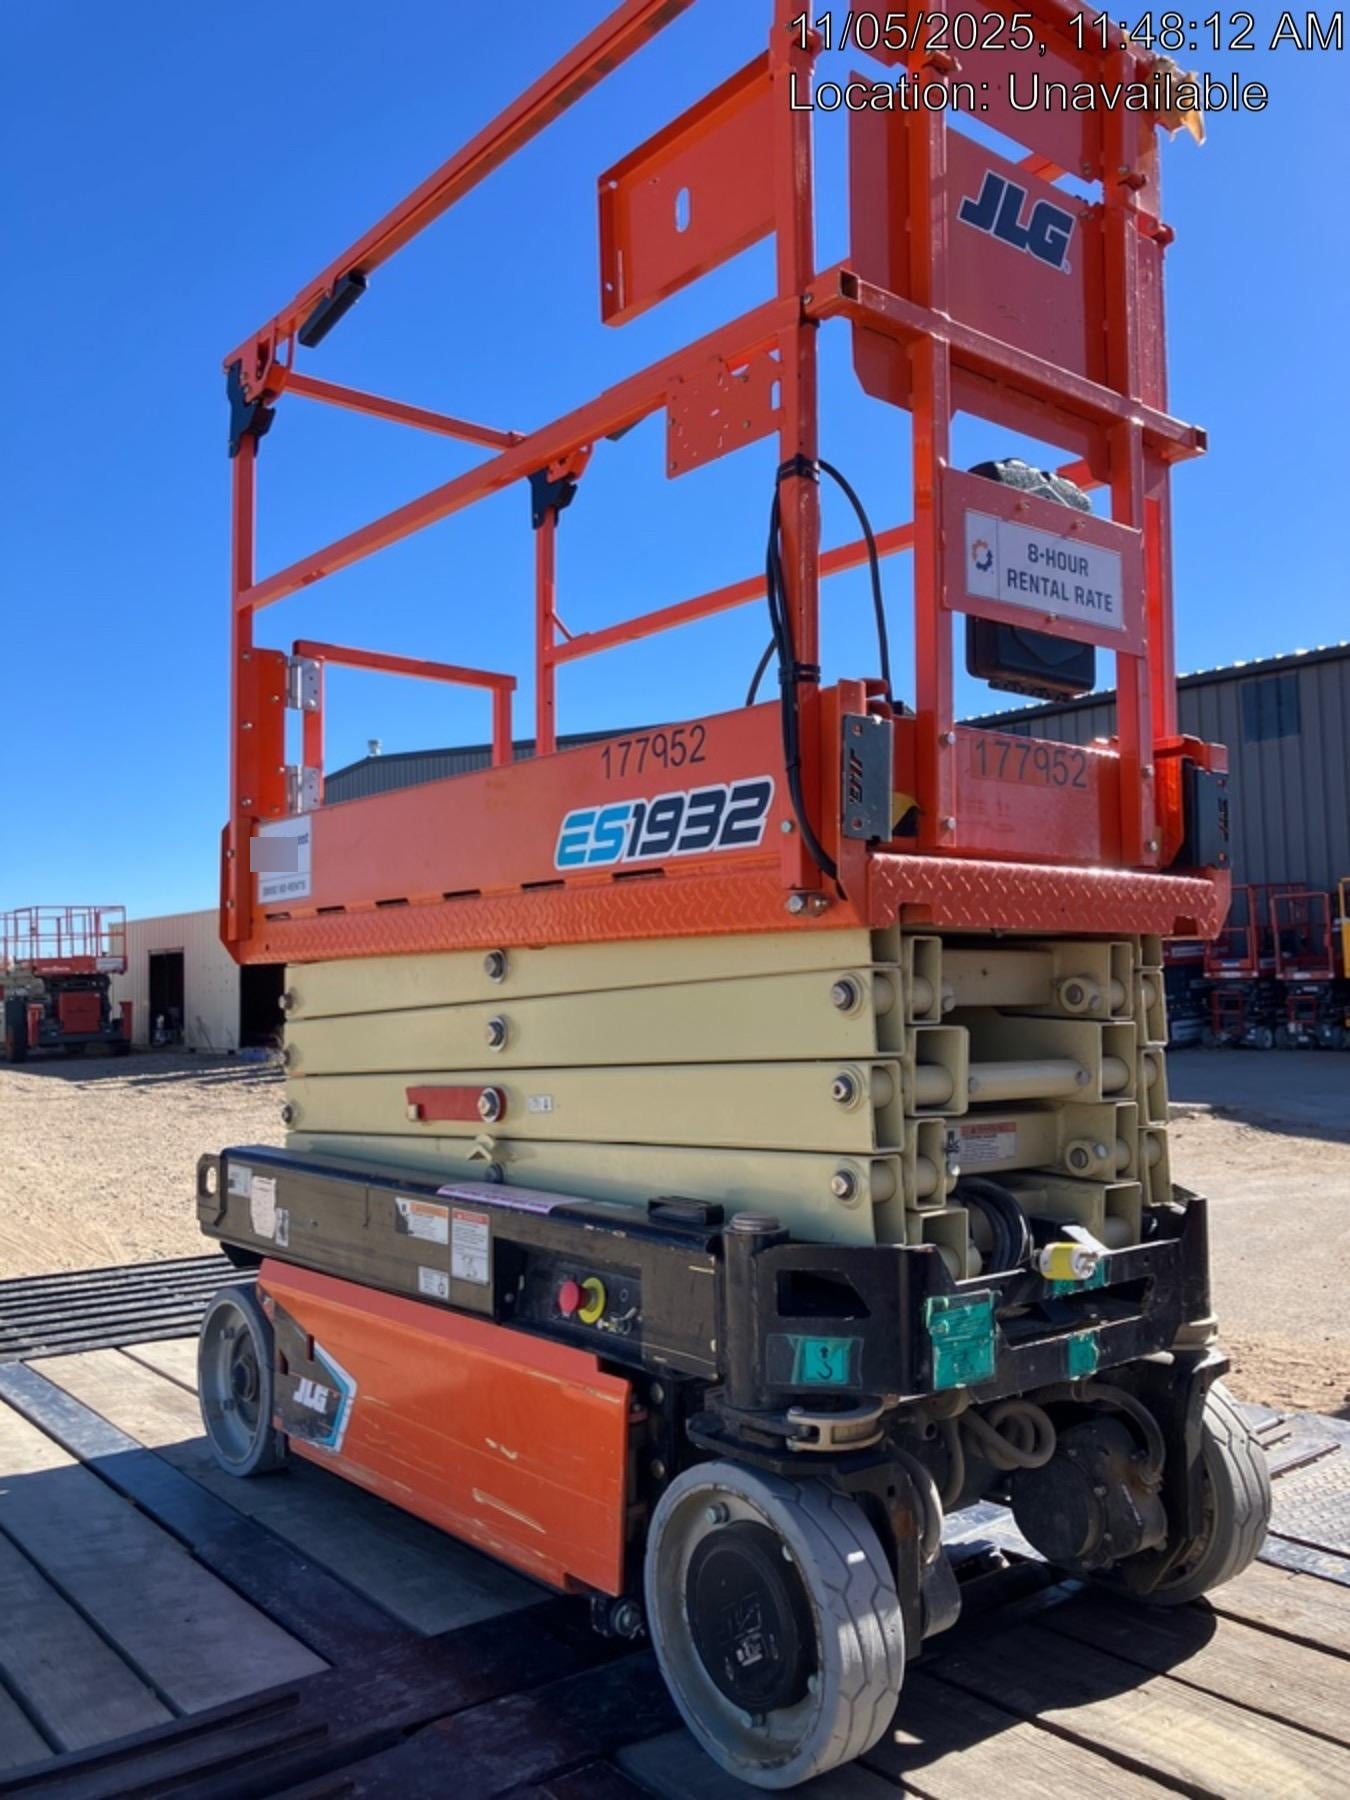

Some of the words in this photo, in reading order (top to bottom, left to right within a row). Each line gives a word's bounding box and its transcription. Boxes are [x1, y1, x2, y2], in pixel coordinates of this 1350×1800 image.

[957, 169, 1077, 271] JLG
[1027, 543, 1089, 577] 8-HOUR
[1007, 568, 1069, 602] RENTAL
[1074, 585, 1113, 612] RATE
[601, 724, 707, 779] 177952
[976, 738, 1087, 788] 177952
[555, 775, 774, 869] ES1932
[292, 1377, 329, 1415] JLG
